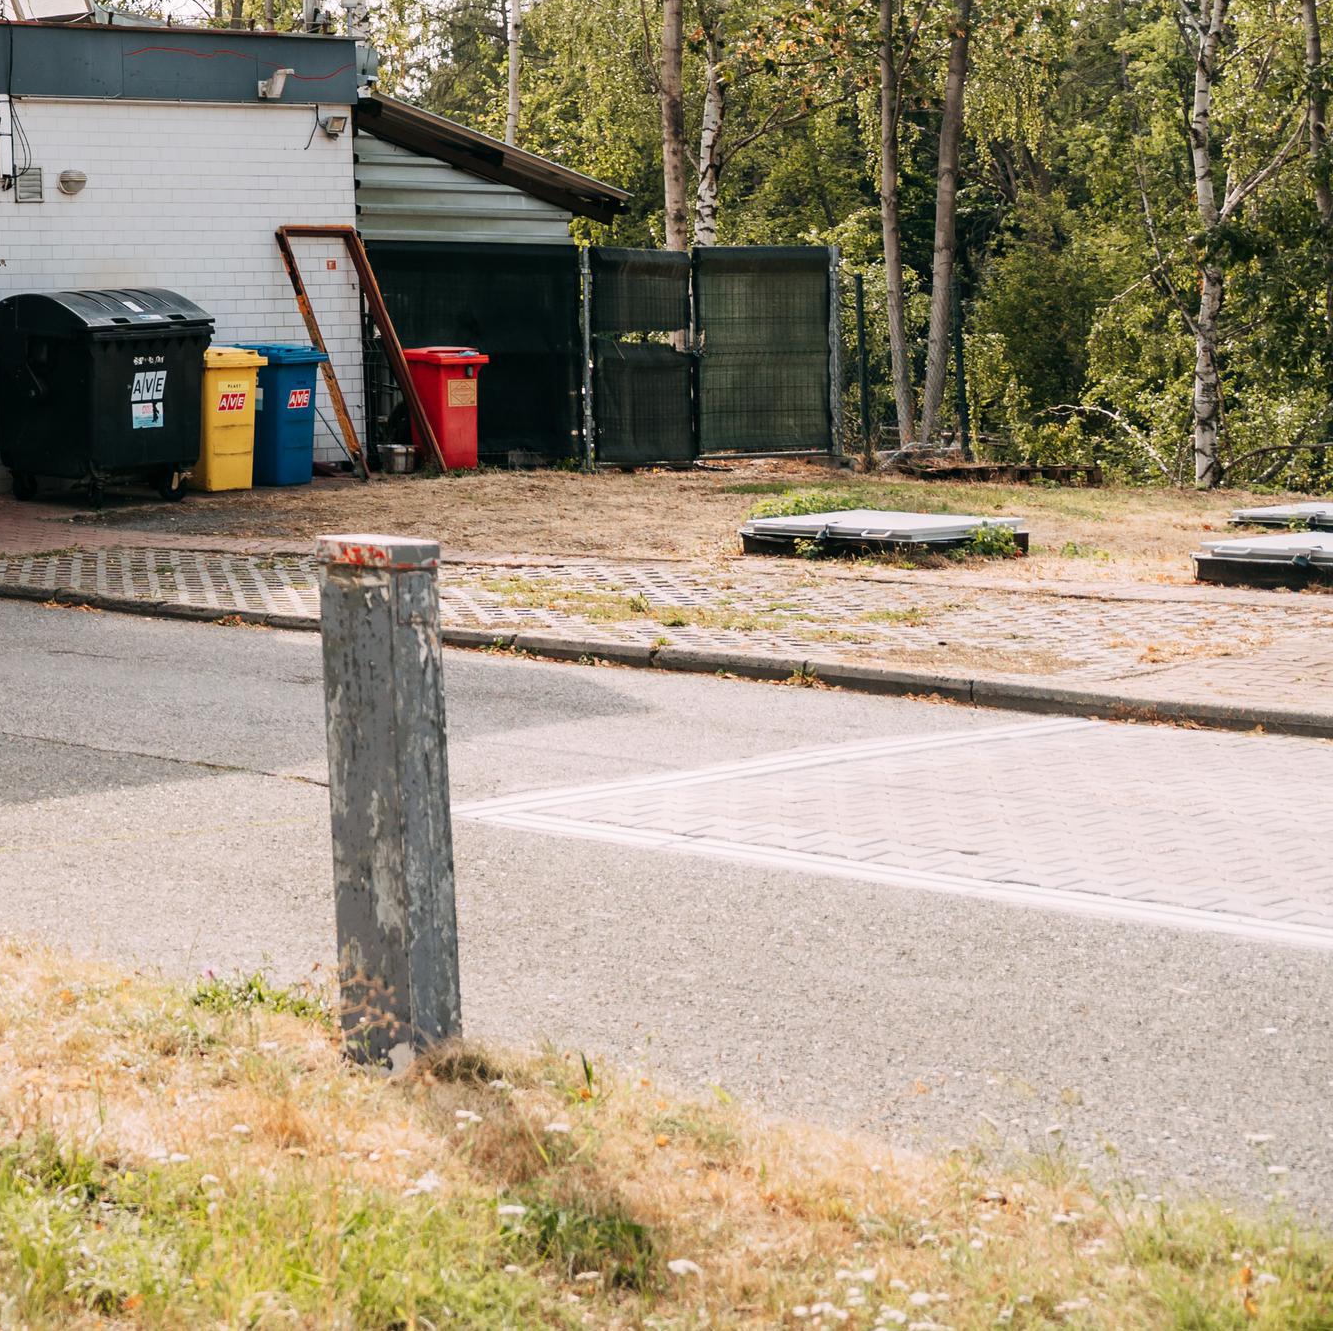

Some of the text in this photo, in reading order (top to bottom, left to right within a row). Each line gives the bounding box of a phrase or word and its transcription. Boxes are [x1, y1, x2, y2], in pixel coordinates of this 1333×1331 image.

[133, 377, 164, 394] AVE
[218, 395, 245, 408] AVE
[288, 392, 310, 406] AVE
